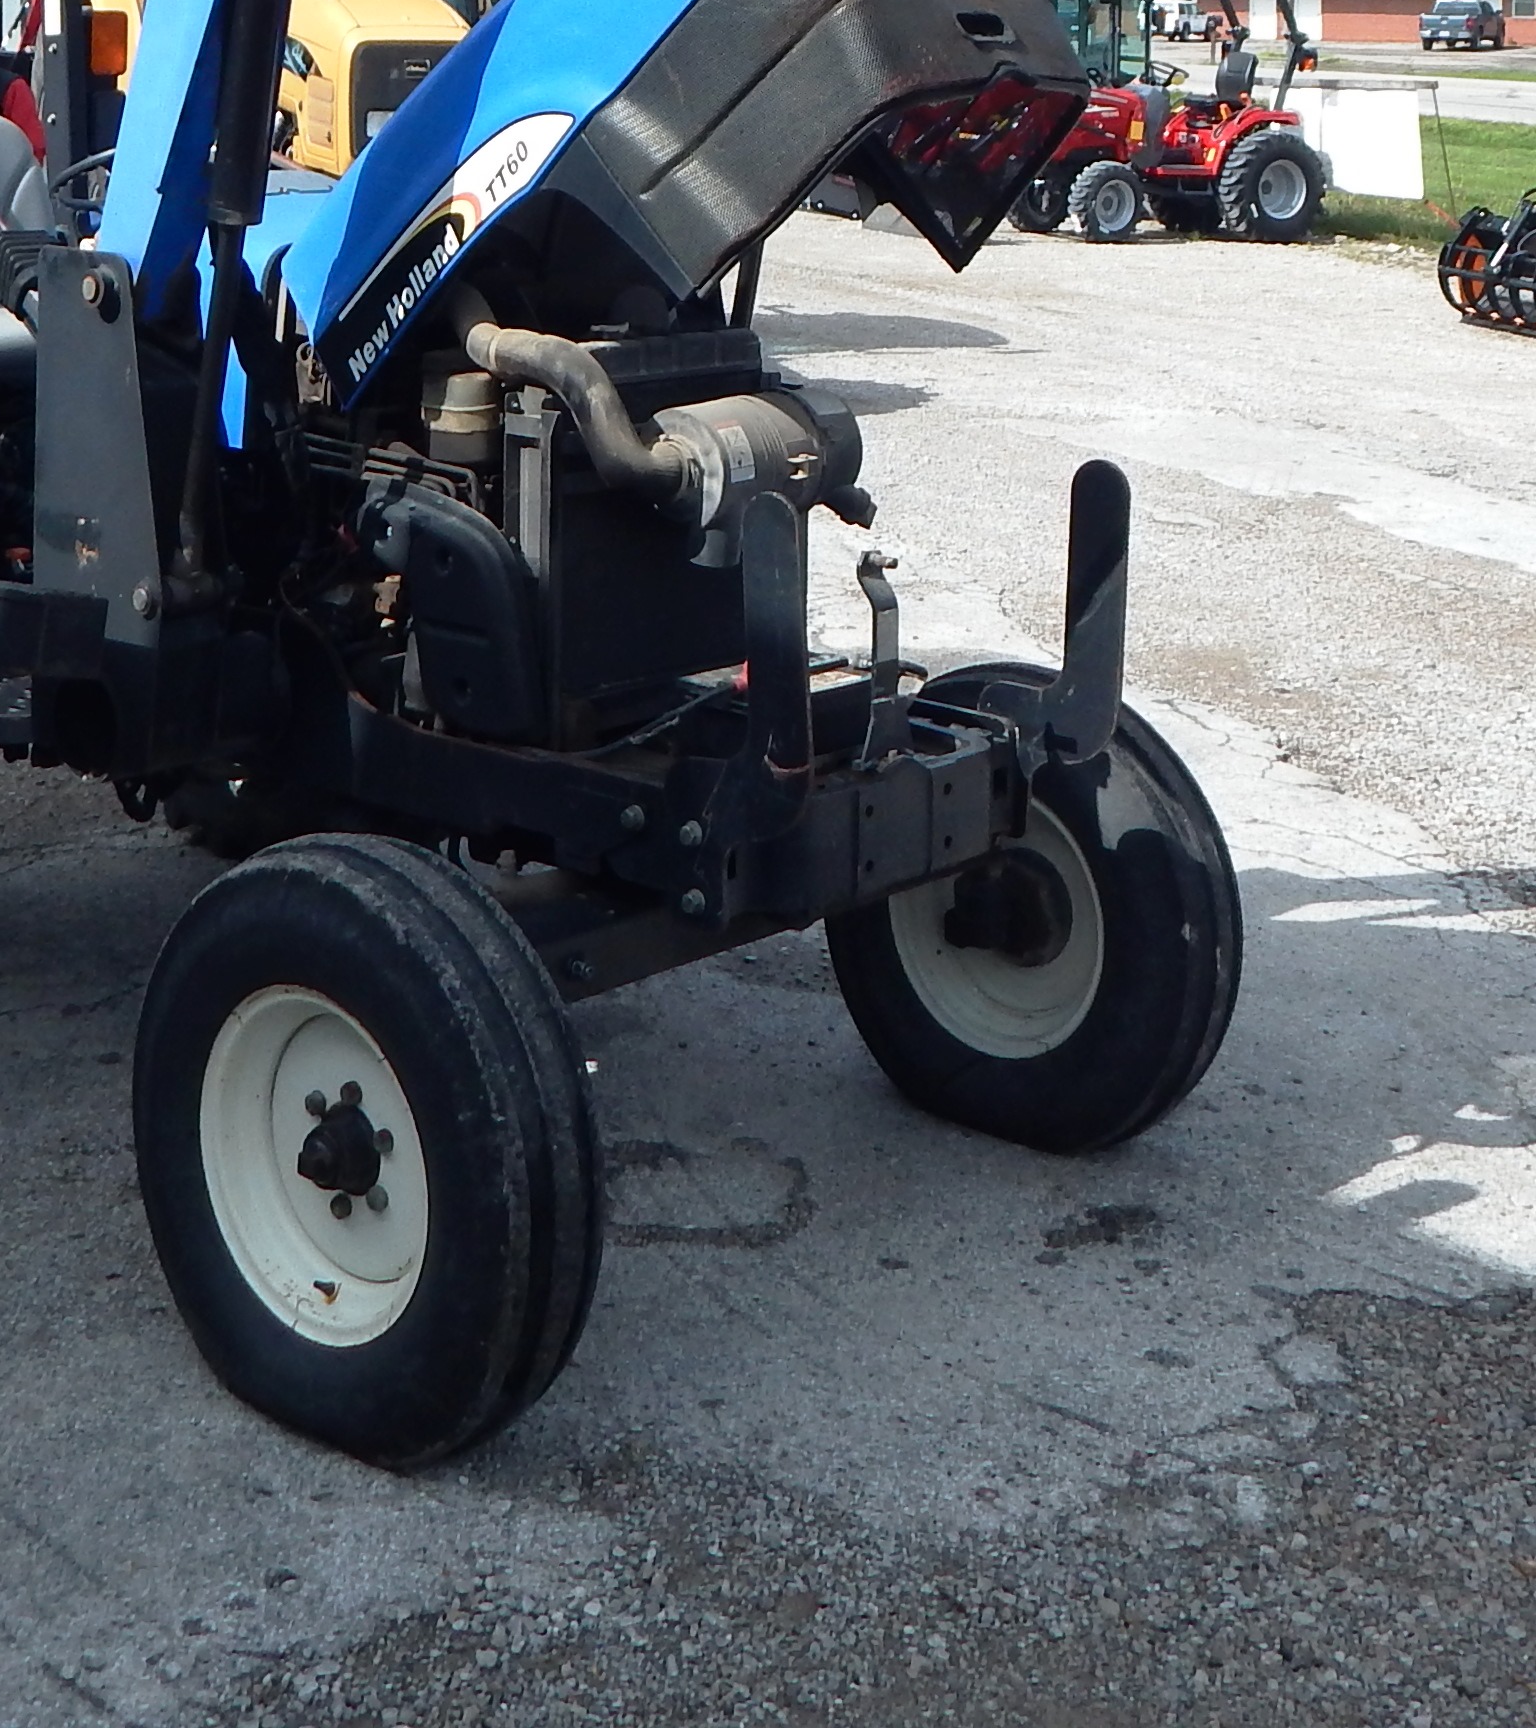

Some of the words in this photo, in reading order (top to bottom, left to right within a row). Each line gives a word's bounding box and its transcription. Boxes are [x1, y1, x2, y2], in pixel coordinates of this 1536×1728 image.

[484, 140, 529, 203] TT60
[348, 321, 391, 383] New
[385, 222, 460, 330] Holland
